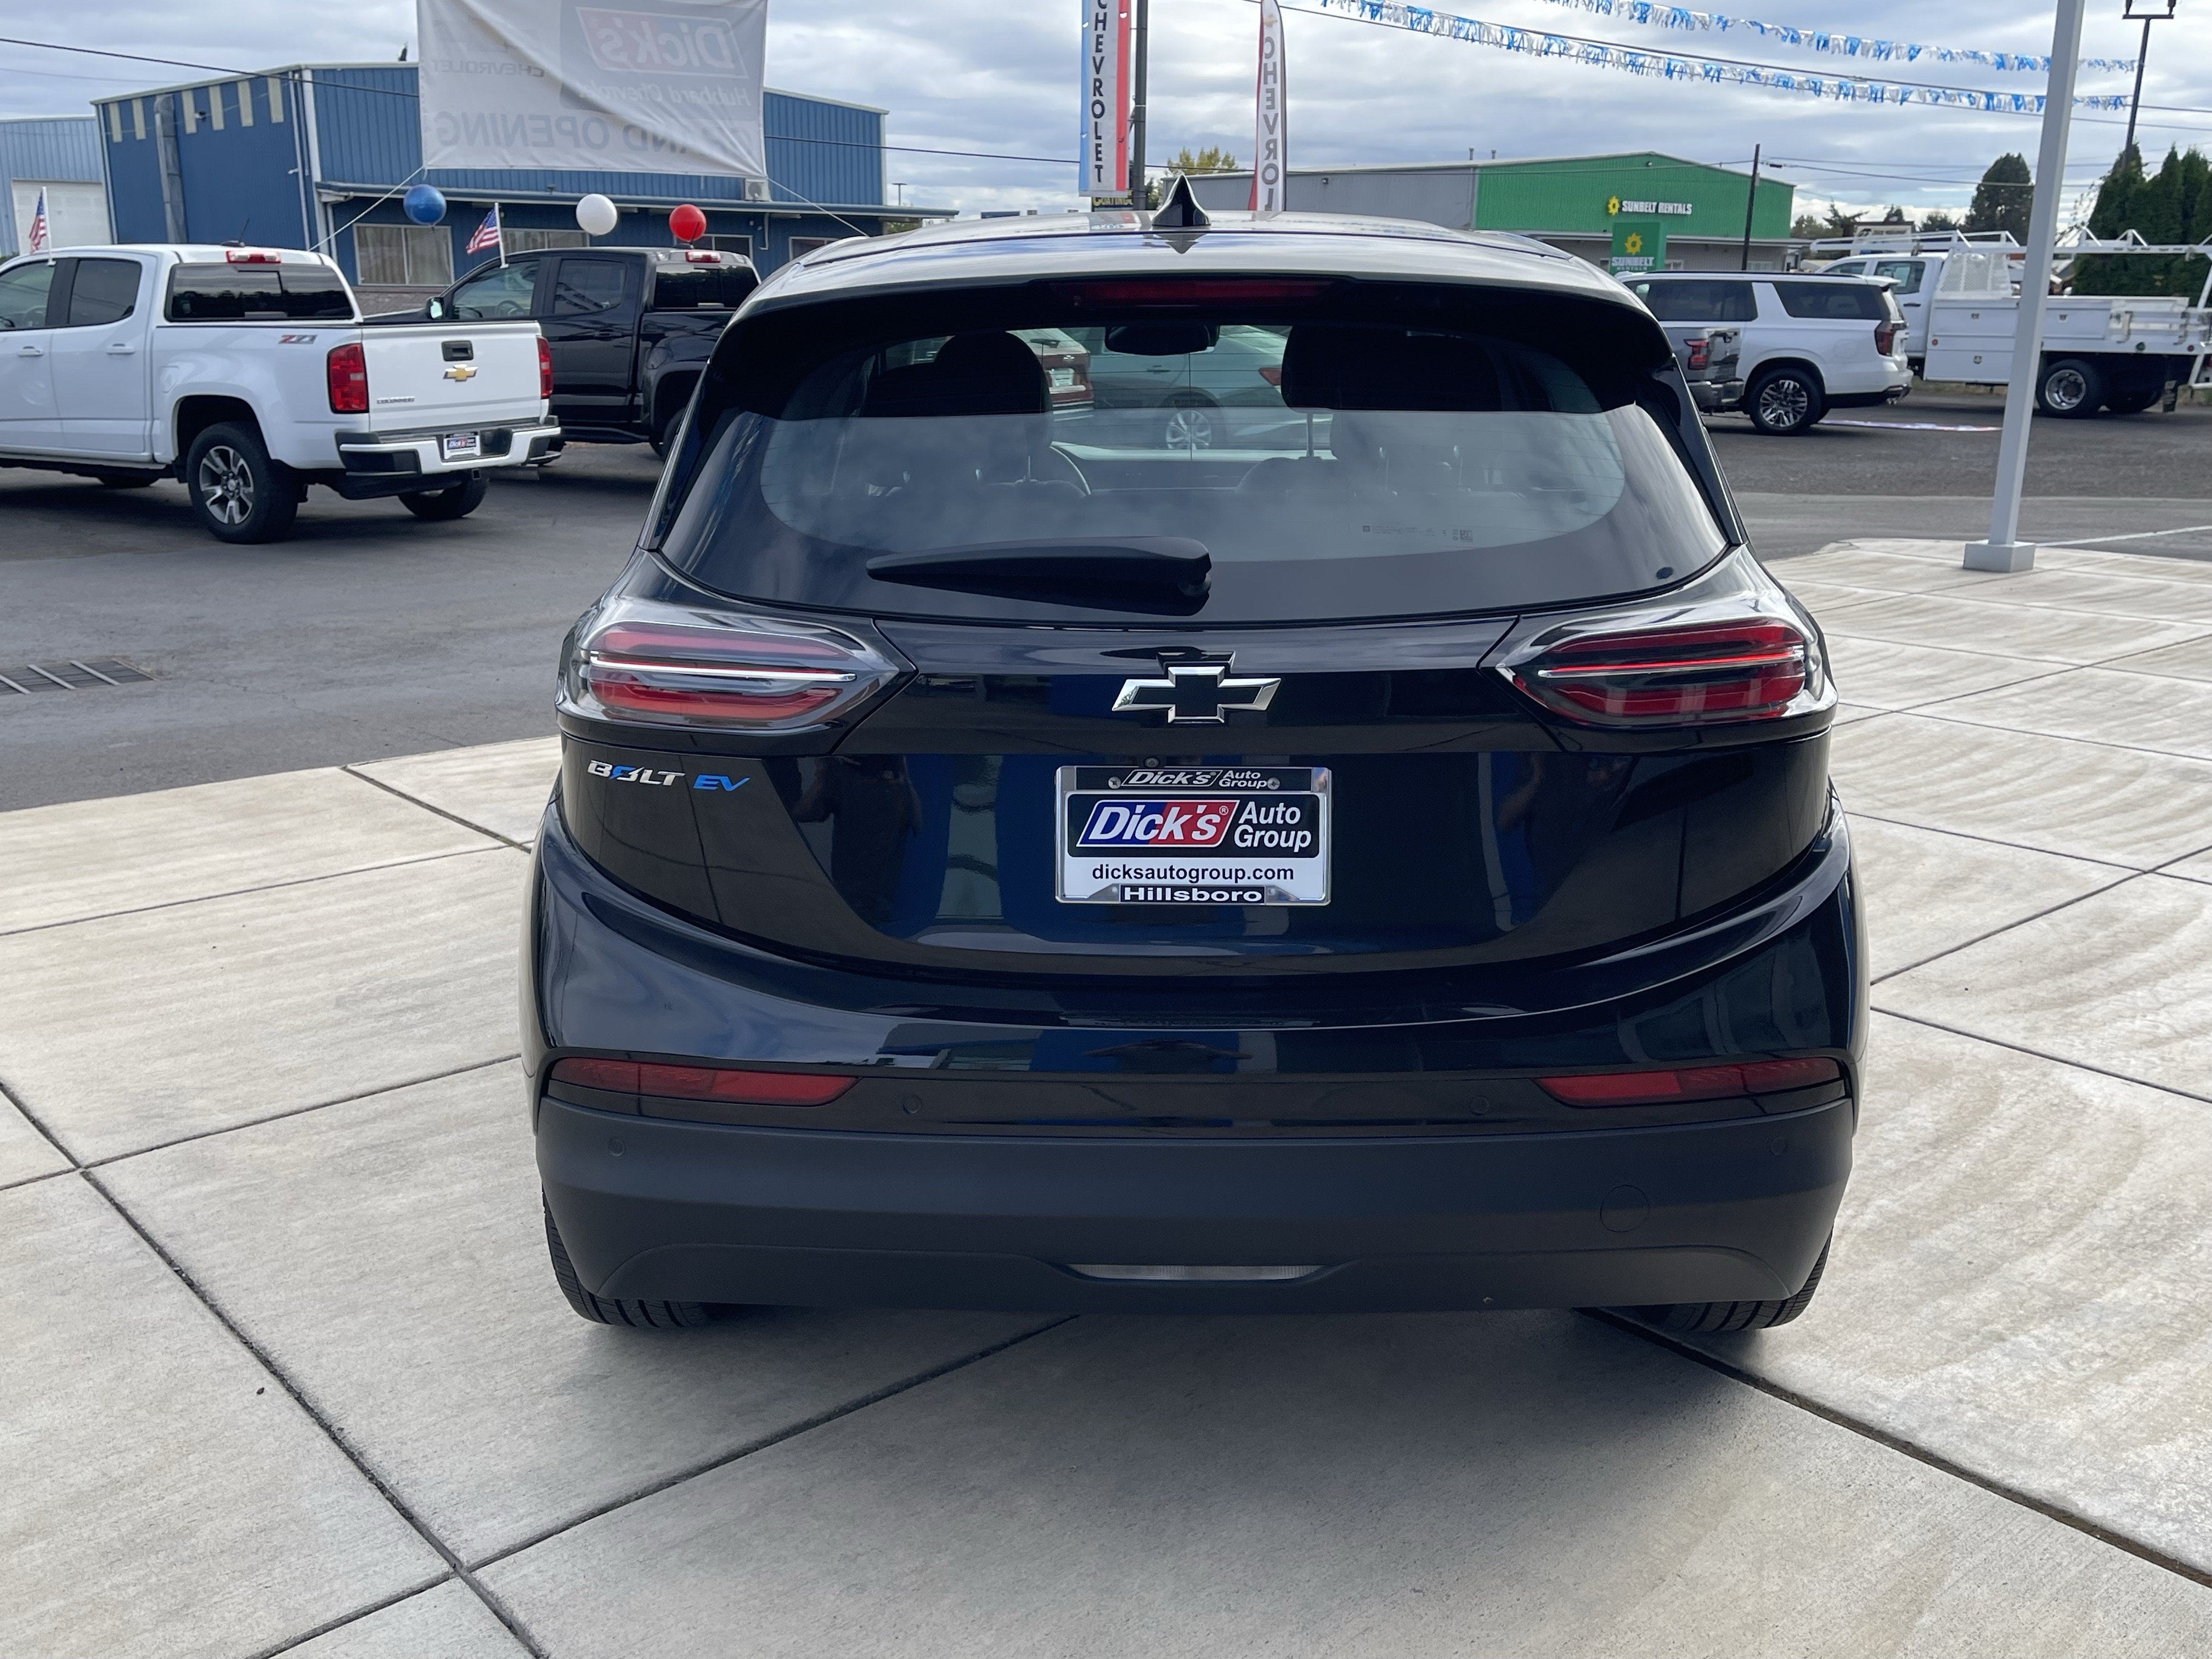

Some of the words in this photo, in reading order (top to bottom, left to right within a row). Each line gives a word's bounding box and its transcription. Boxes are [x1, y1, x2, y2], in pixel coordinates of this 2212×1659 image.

[1622, 200, 1657, 213] SUNBELT
[1657, 202, 1693, 215] RENTALS
[587, 759, 686, 786] BOLT
[692, 774, 751, 792] EV
[1128, 770, 1211, 785] Dick's
[1223, 770, 1261, 779] Auto
[1218, 778, 1267, 789] Group
[1238, 801, 1301, 825] Auto
[1088, 804, 1221, 841] Dick's
[1234, 824, 1312, 853] Group
[1092, 864, 1294, 883] dicksautogroup.com
[1124, 887, 1262, 902] Hillsboro
